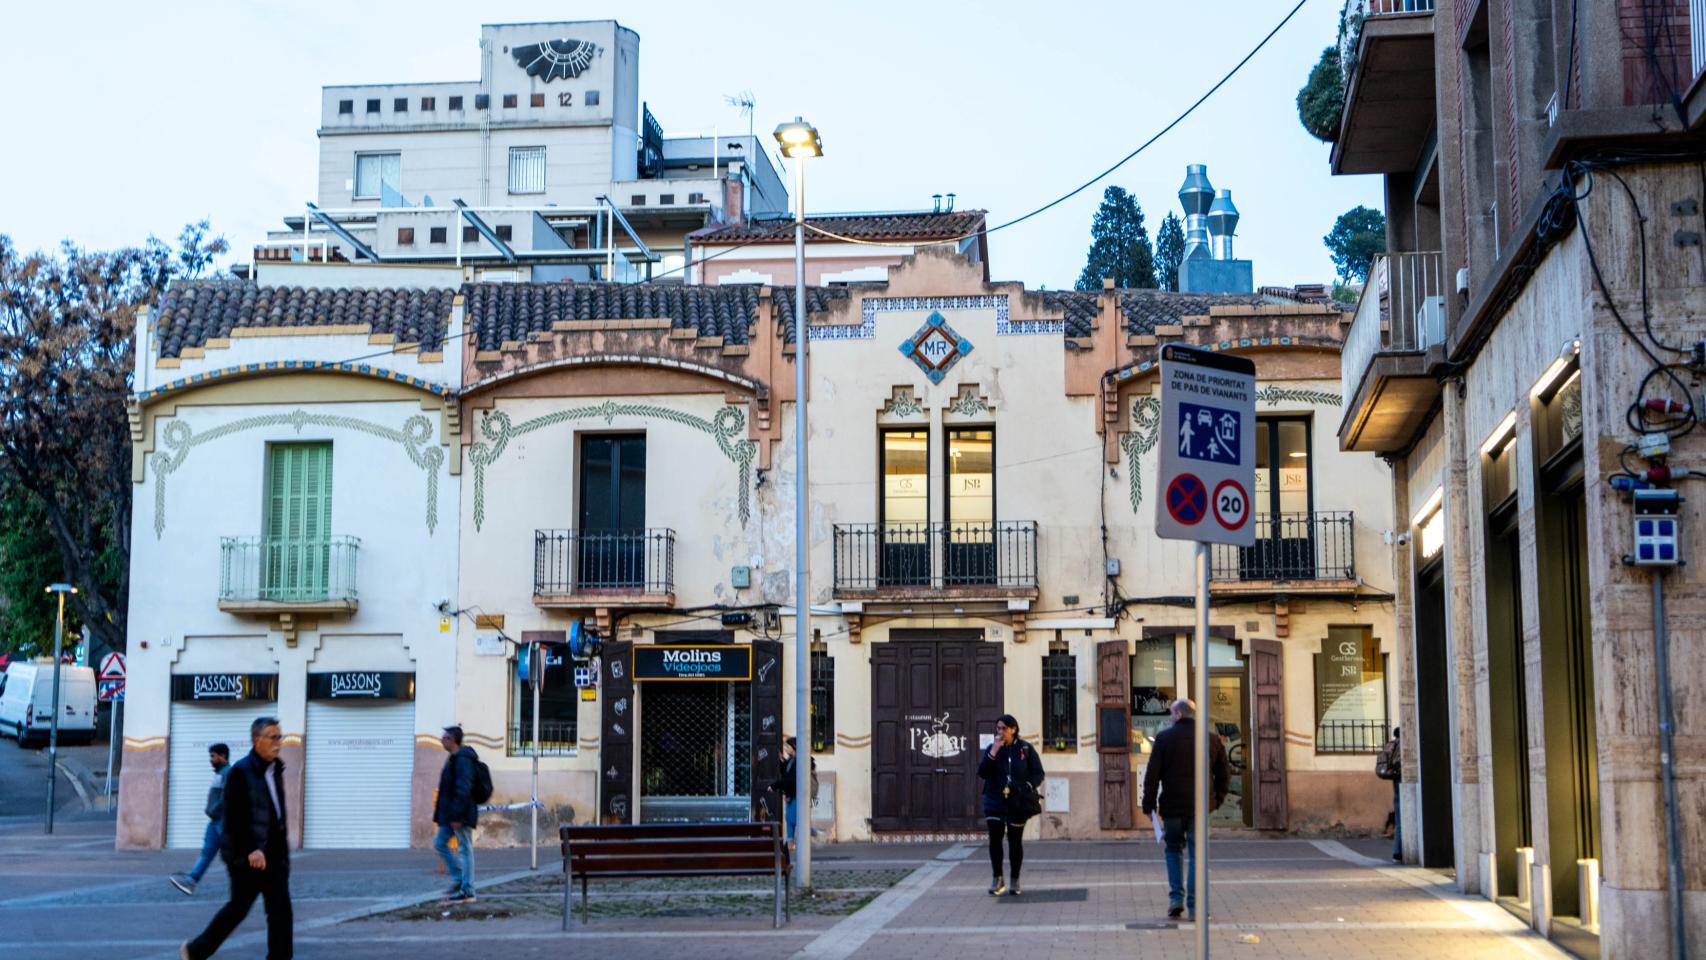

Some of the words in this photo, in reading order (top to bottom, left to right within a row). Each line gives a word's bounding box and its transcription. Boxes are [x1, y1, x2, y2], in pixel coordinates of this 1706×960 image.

[558, 92, 572, 107] 12
[924, 341, 946, 355] MR
[1173, 369, 1195, 381] ZONA
[1196, 373, 1207, 384] DE
[1208, 376, 1246, 390] PRIORITAT
[1171, 381, 1182, 391] DE
[1183, 383, 1199, 393] PAS
[1200, 386, 1210, 396] DE
[1211, 388, 1248, 401] VIANANTS
[1221, 495, 1242, 513] 20
[663, 649, 721, 662] Molins
[1338, 641, 1357, 655] GS
[663, 662, 721, 673] Videojocs
[194, 675, 243, 694] BASSONS
[331, 673, 381, 692] BASSONS
